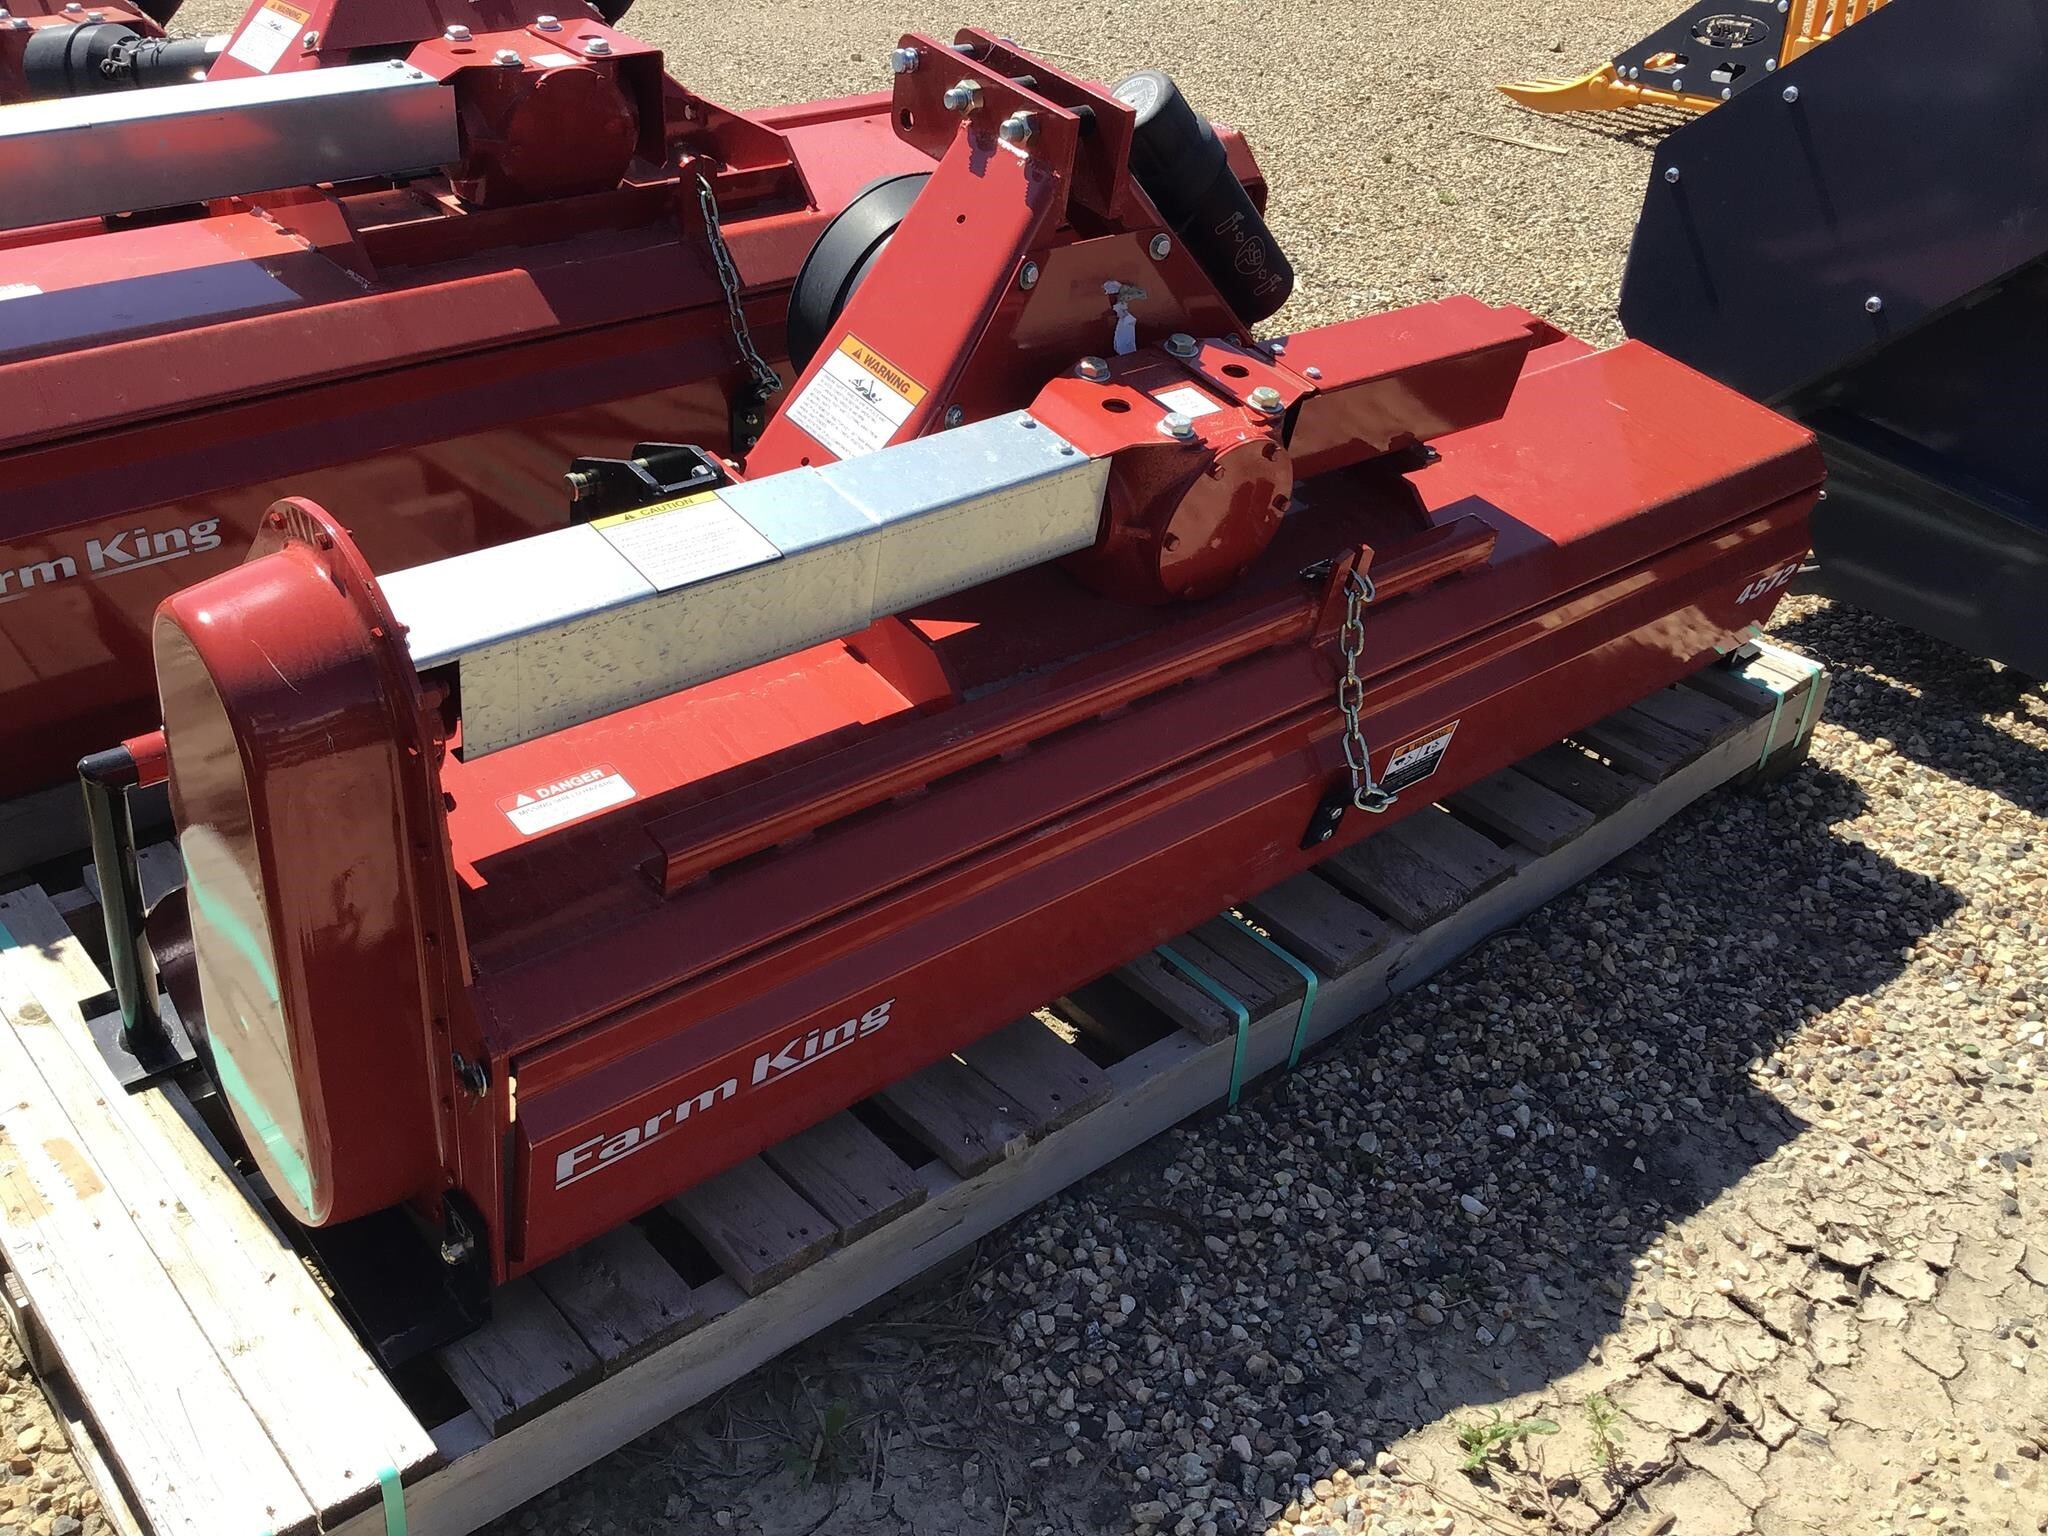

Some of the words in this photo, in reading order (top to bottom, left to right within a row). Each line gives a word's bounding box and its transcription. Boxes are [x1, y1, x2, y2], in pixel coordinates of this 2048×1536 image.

[863, 353, 911, 394] WARNING
[640, 497, 694, 516] CAUTION
[85, 517, 222, 572] King
[1734, 563, 1798, 605] 4572
[535, 769, 605, 799] DANGER
[555, 1077, 738, 1183] Farm
[751, 998, 896, 1086] King
